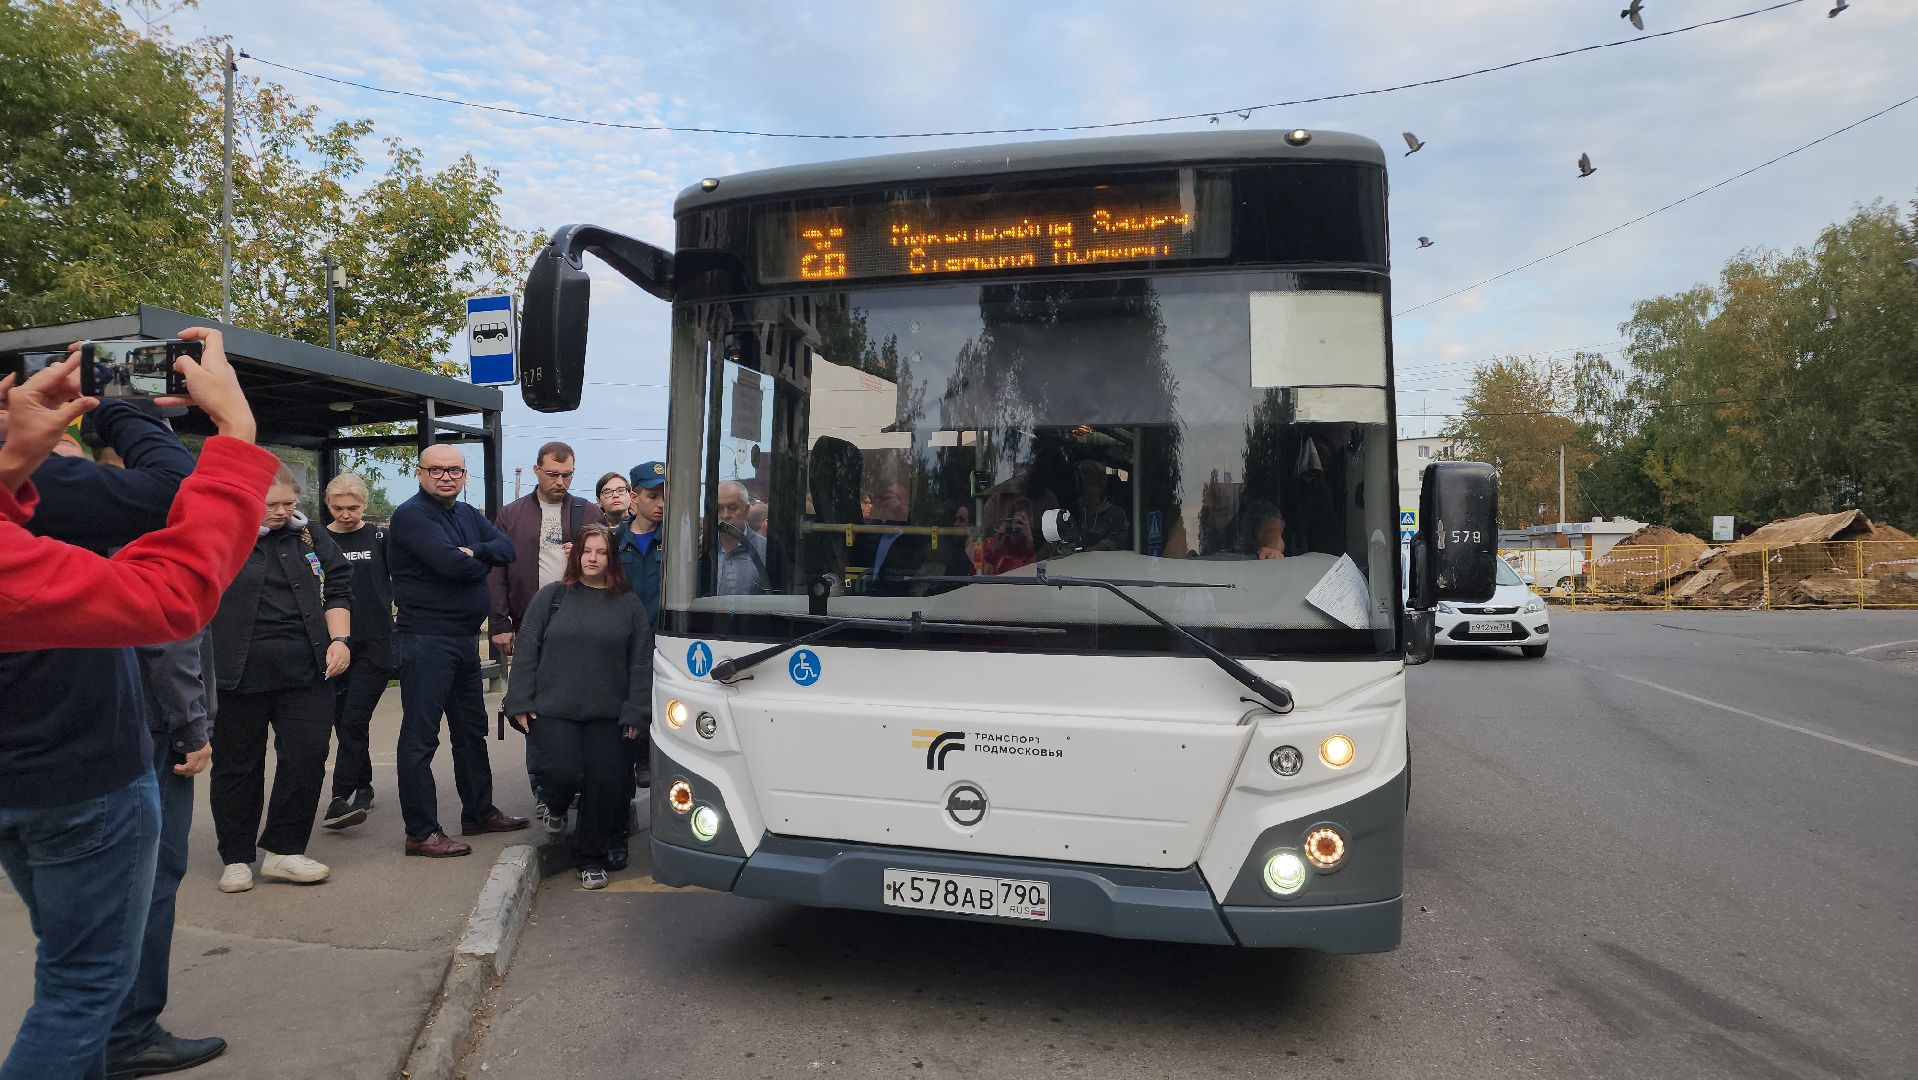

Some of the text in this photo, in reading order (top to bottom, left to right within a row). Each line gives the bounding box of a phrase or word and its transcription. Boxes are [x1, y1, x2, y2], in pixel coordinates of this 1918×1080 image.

[1451, 530, 1481, 543] 578
[975, 732, 1040, 744] ТРАНСПОРТ
[974, 744, 1063, 758] ПОДМОСКОВЬЯ
[1000, 882, 1041, 906] 790
[1009, 905, 1030, 915] RUS
